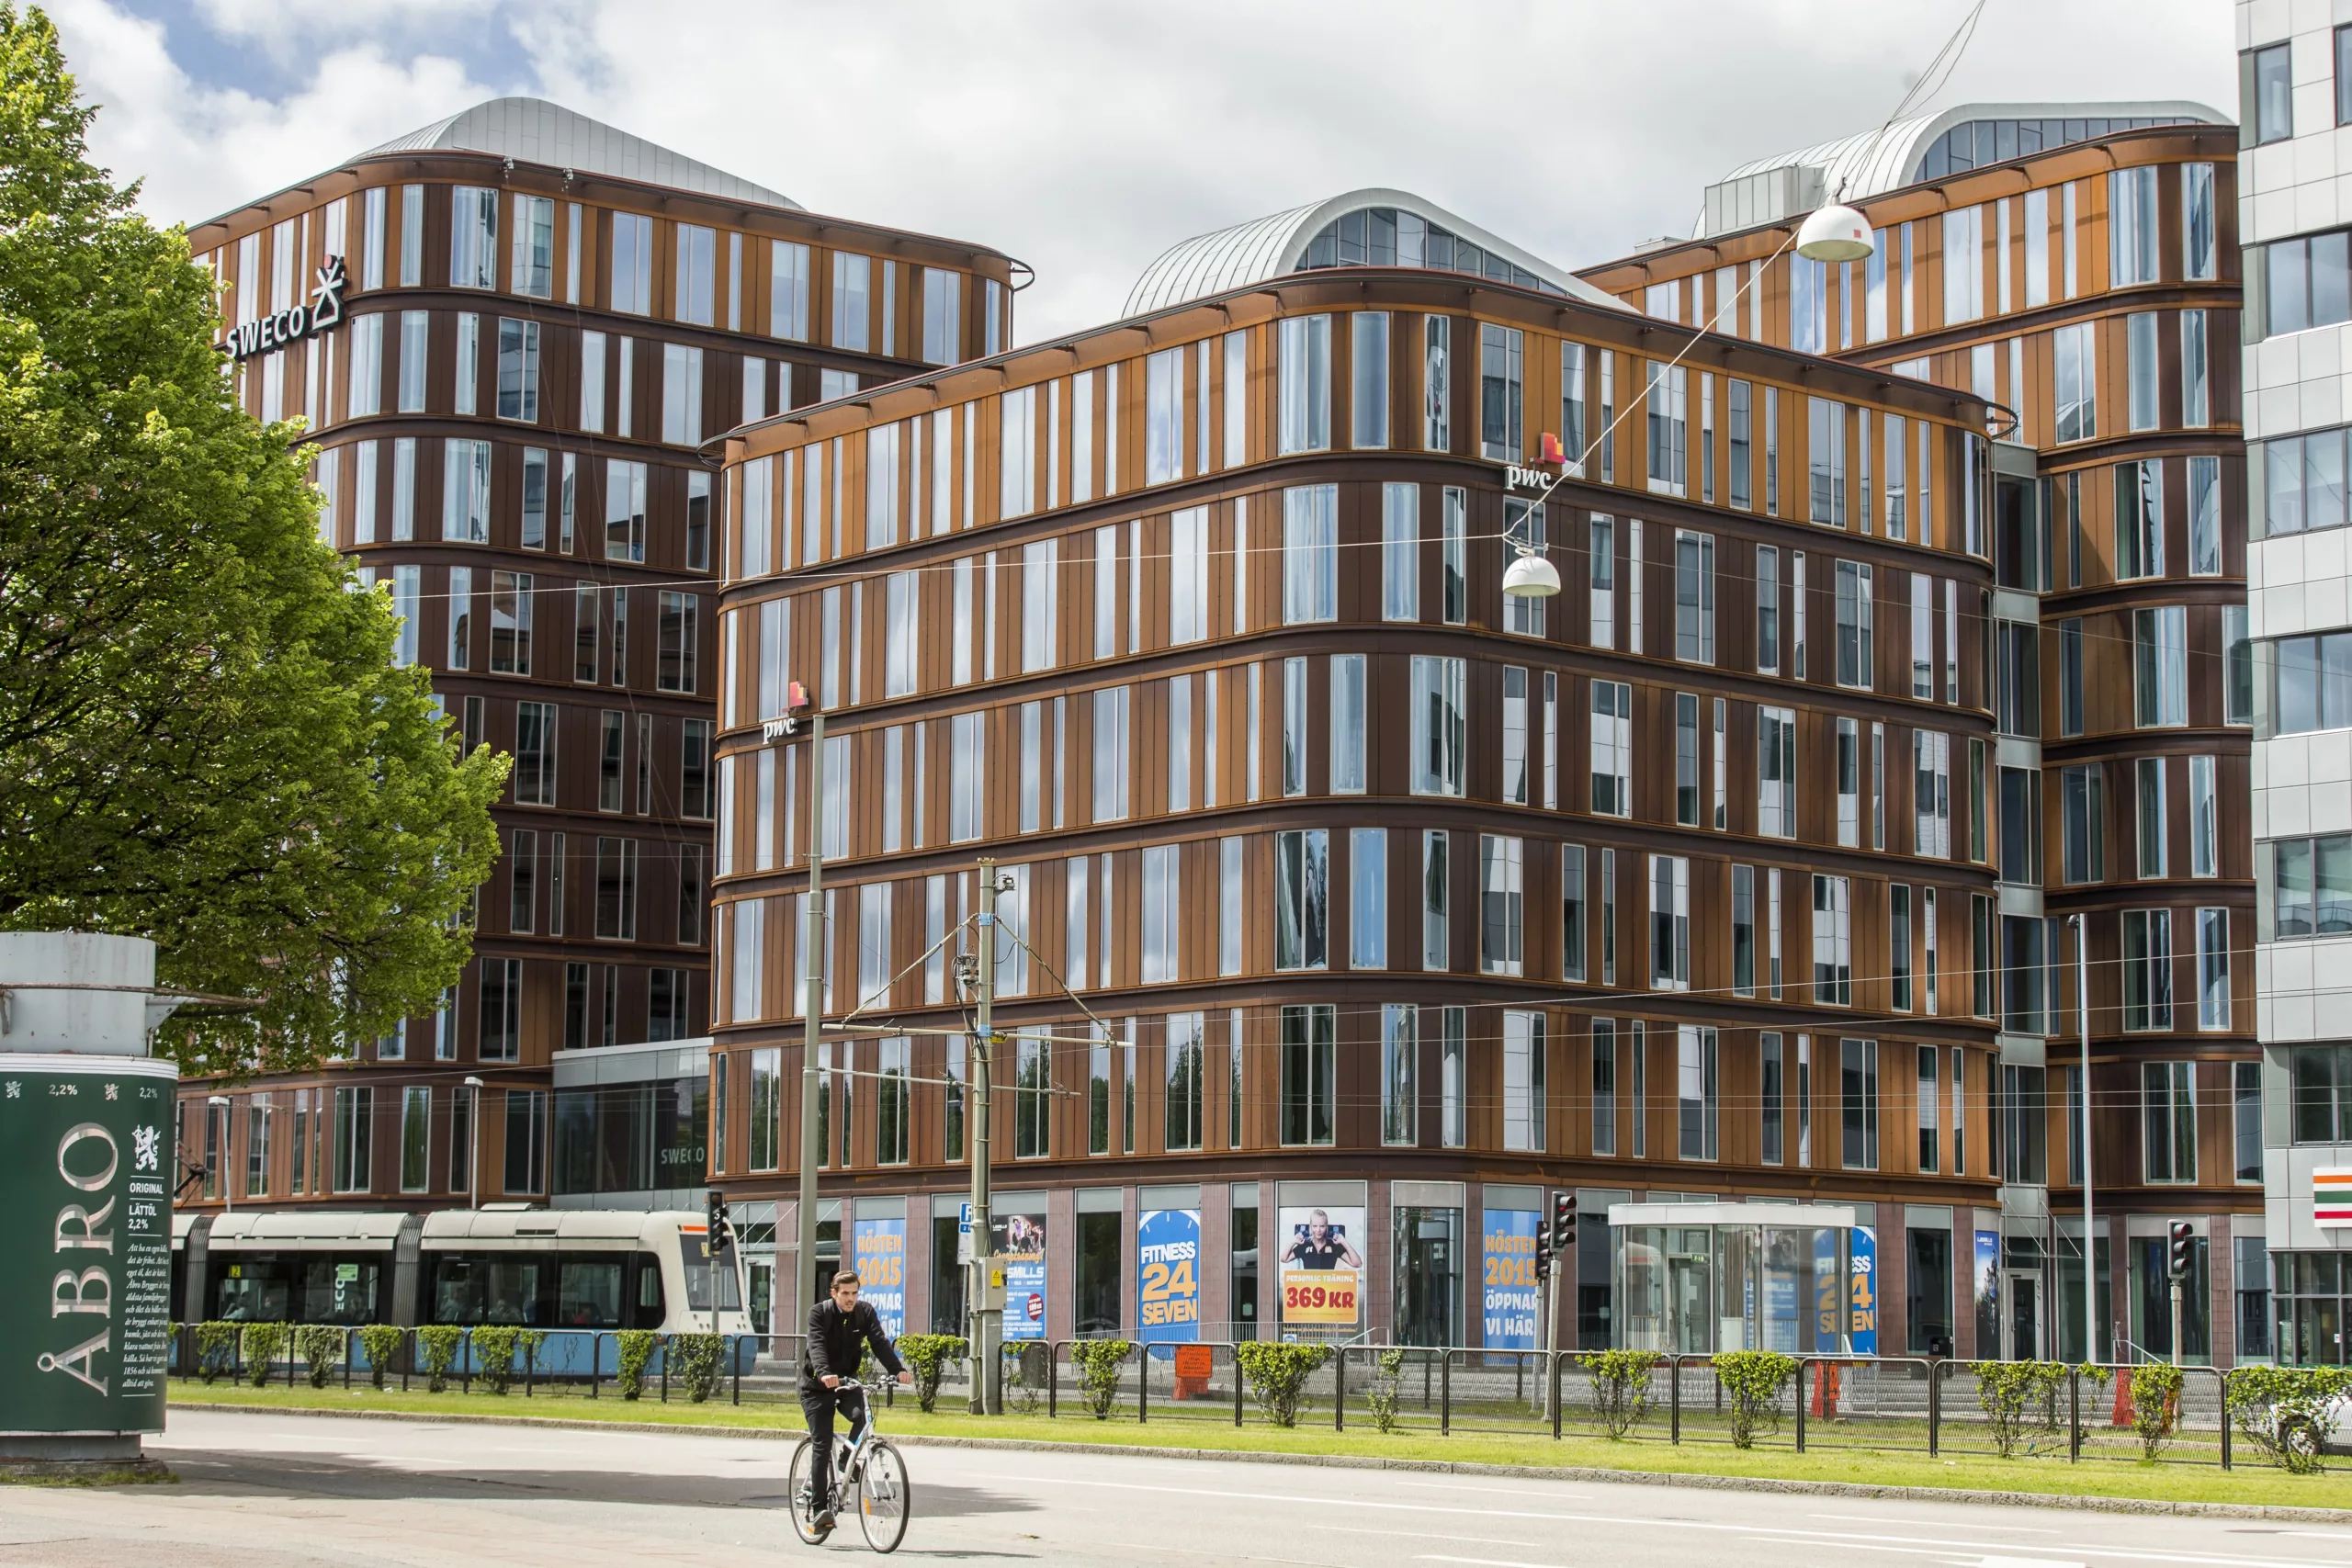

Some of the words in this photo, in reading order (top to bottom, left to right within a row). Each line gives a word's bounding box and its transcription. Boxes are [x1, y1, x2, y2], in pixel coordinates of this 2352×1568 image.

[226, 305, 304, 359] SWECO
[1504, 465, 1552, 491] pwc
[762, 717, 797, 745] pwc
[49, 1084, 78, 1097] 2,2%
[140, 1087, 158, 1100] 2,2%
[130, 1182, 164, 1194] ORIGINAL
[129, 1202, 157, 1216] LÄTTÖL
[128, 1218, 149, 1231] 2,2%
[857, 1229, 902, 1254] HÖSTEN
[1141, 1241, 1196, 1264] FITNESS
[1486, 1229, 1537, 1255] HÖSTEN
[37, 1122, 119, 1397] ÅBRO
[857, 1257, 902, 1287] 2015
[1007, 1266, 1045, 1279] SMILLS
[1142, 1260, 1197, 1303] 24
[1286, 1274, 1321, 1283] PERSONLIG
[1323, 1273, 1354, 1283] TRÄNING
[1486, 1257, 1539, 1287] 2015
[1286, 1286, 1326, 1309] 369
[1329, 1291, 1355, 1309] KR
[1142, 1299, 1198, 1325] SEVEN
[880, 1314, 902, 1337] ÄR!
[1485, 1317, 1501, 1336] VI
[1504, 1314, 1534, 1337] HÄR
[123, 1366, 138, 1376] 1856
